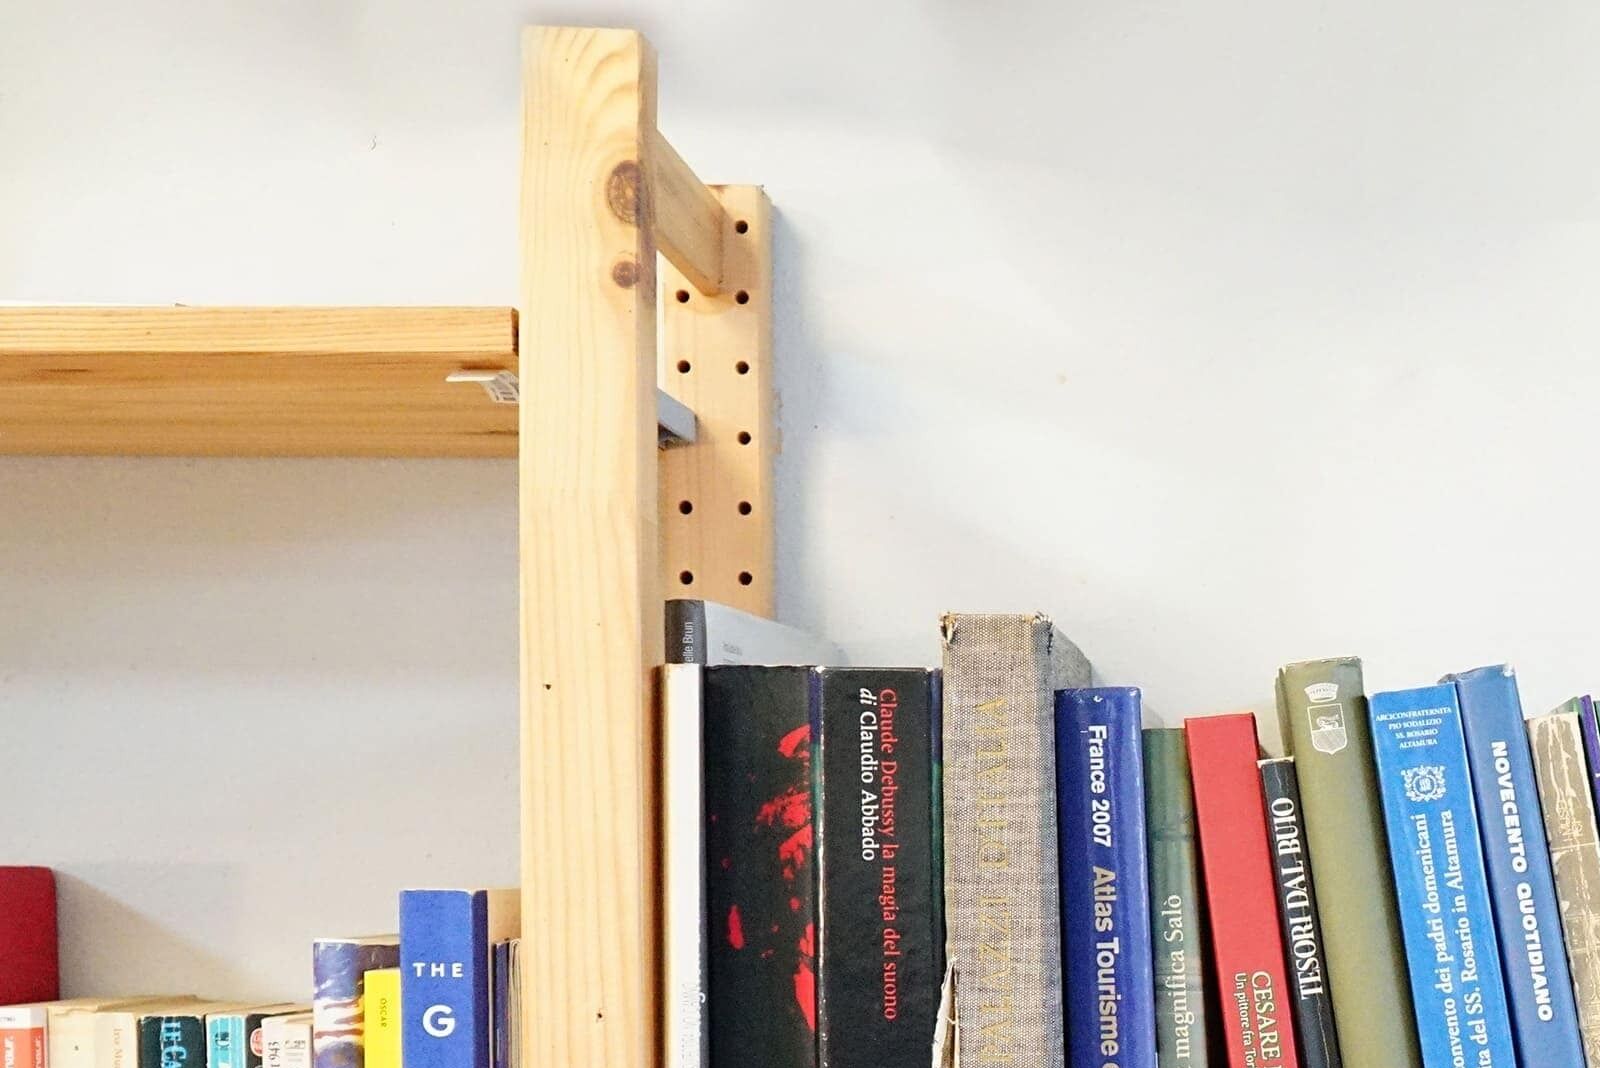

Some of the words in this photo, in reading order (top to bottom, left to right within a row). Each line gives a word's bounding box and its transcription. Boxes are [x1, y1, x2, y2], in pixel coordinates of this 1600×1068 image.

[682, 622, 694, 645] Brun
[859, 688, 877, 706] di
[879, 688, 898, 753] Claude
[859, 711, 878, 784] Claudio
[1087, 725, 1108, 794] France
[860, 789, 879, 861] Abbado
[878, 760, 898, 837] Debussy
[1091, 799, 1112, 847] 2007
[1270, 797, 1302, 856] BUIO
[881, 844, 899, 860] la
[1411, 813, 1441, 914] domenicani
[1440, 809, 1465, 891] Altamura
[879, 866, 900, 922] magia
[1092, 865, 1117, 932] Atlas
[1280, 860, 1310, 909] DAL
[1451, 894, 1468, 913] in
[1491, 741, 1529, 873] NOVECENTO
[1515, 882, 1554, 1022] QUOTIDIANO
[882, 928, 901, 956] del
[1162, 894, 1184, 943] Salò
[1427, 918, 1455, 963] padri
[413, 962, 464, 978] THE
[1289, 915, 1324, 1001] TESORI
[1453, 916, 1479, 982] Rosario
[882, 962, 898, 1020] suono
[977, 895, 1013, 1064] PALAZZI
[1095, 937, 1122, 1056] Tourisme
[1170, 949, 1195, 1059] magnifica
[1234, 973, 1247, 990] Un
[1435, 967, 1454, 994] dei
[1463, 987, 1484, 1015] SS.
[378, 998, 388, 1029] OSCAR
[1233, 992, 1252, 1029] pittore
[1241, 1030, 1255, 1047] fra
[1251, 971, 1281, 1061] CESARE
[1468, 1019, 1489, 1045] del
